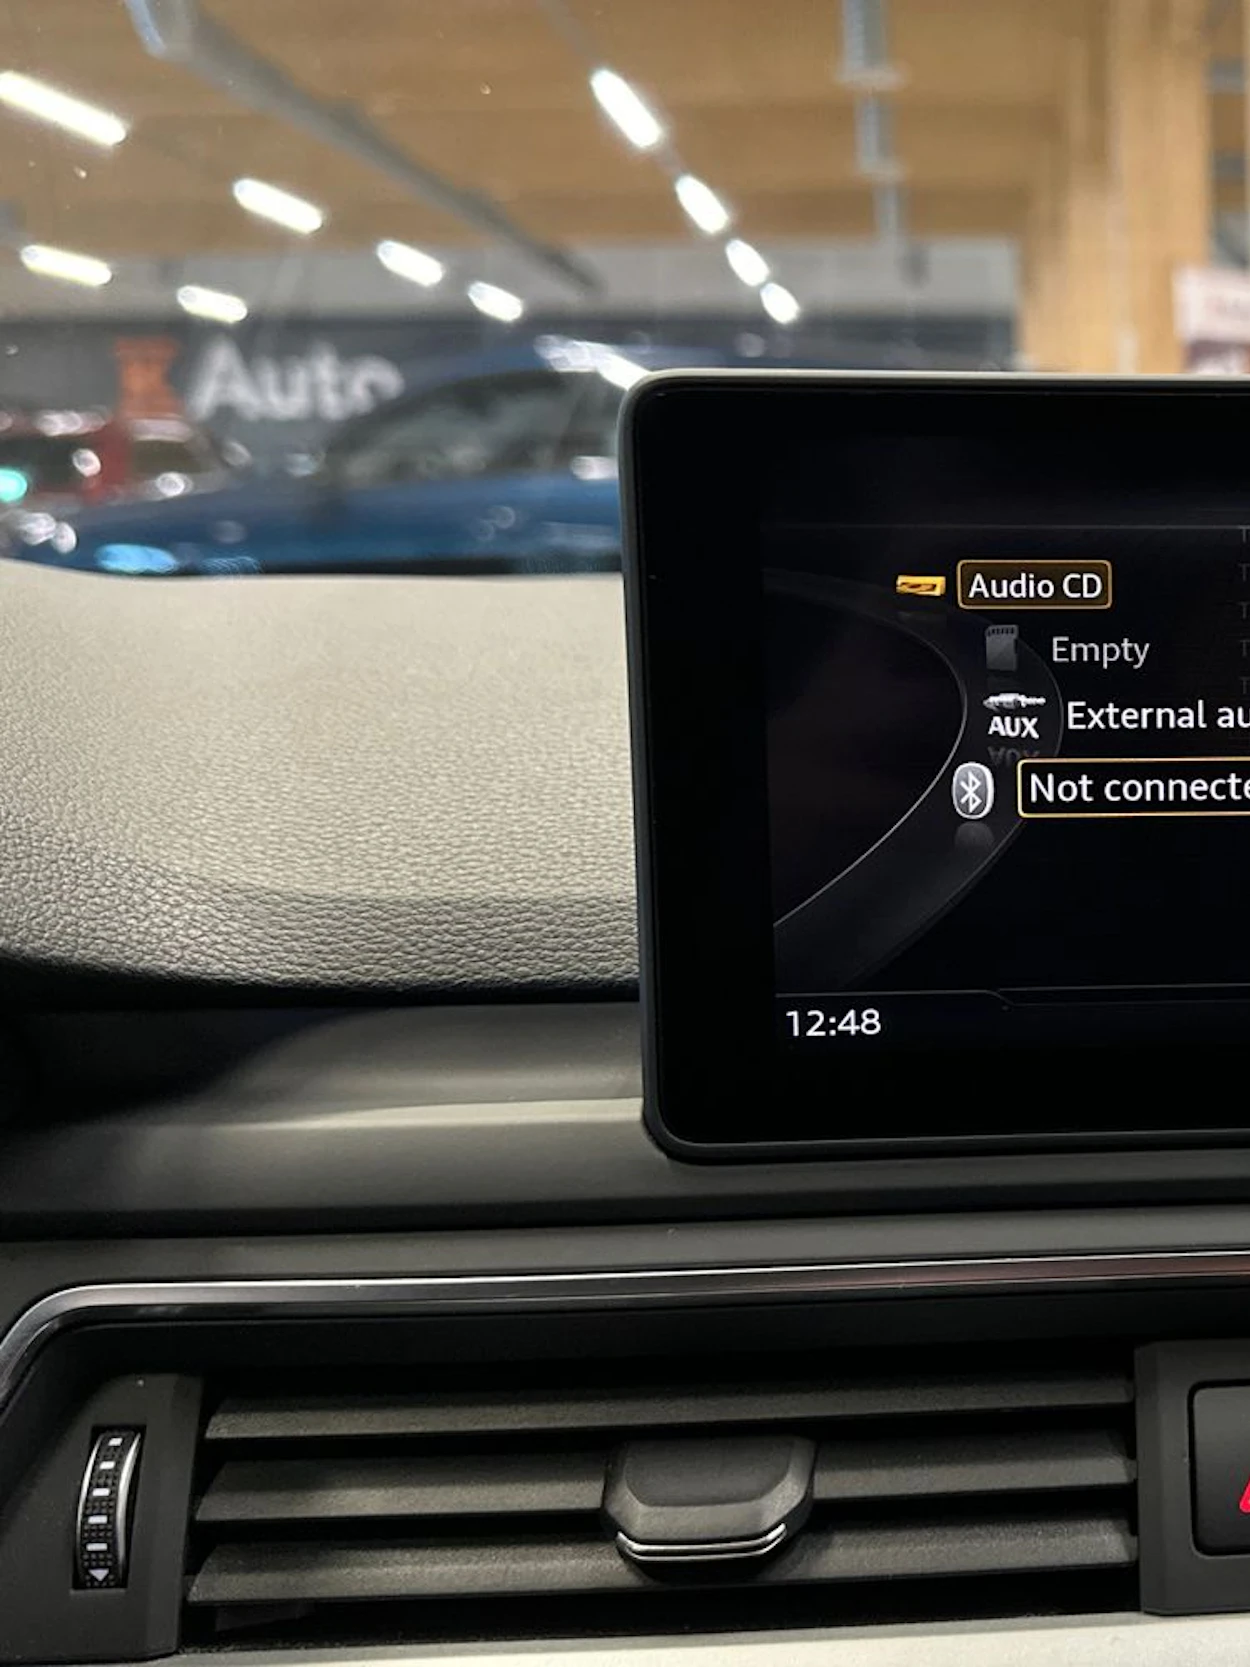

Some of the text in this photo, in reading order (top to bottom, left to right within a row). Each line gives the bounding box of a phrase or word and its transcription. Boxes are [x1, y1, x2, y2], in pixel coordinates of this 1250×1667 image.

[968, 573, 1103, 600] Audio CD
[1052, 637, 1150, 670] Empty
[987, 715, 1040, 740] AUX
[1067, 698, 1207, 731] External
[1030, 773, 1094, 804] Not
[785, 1008, 882, 1037] 12:48
